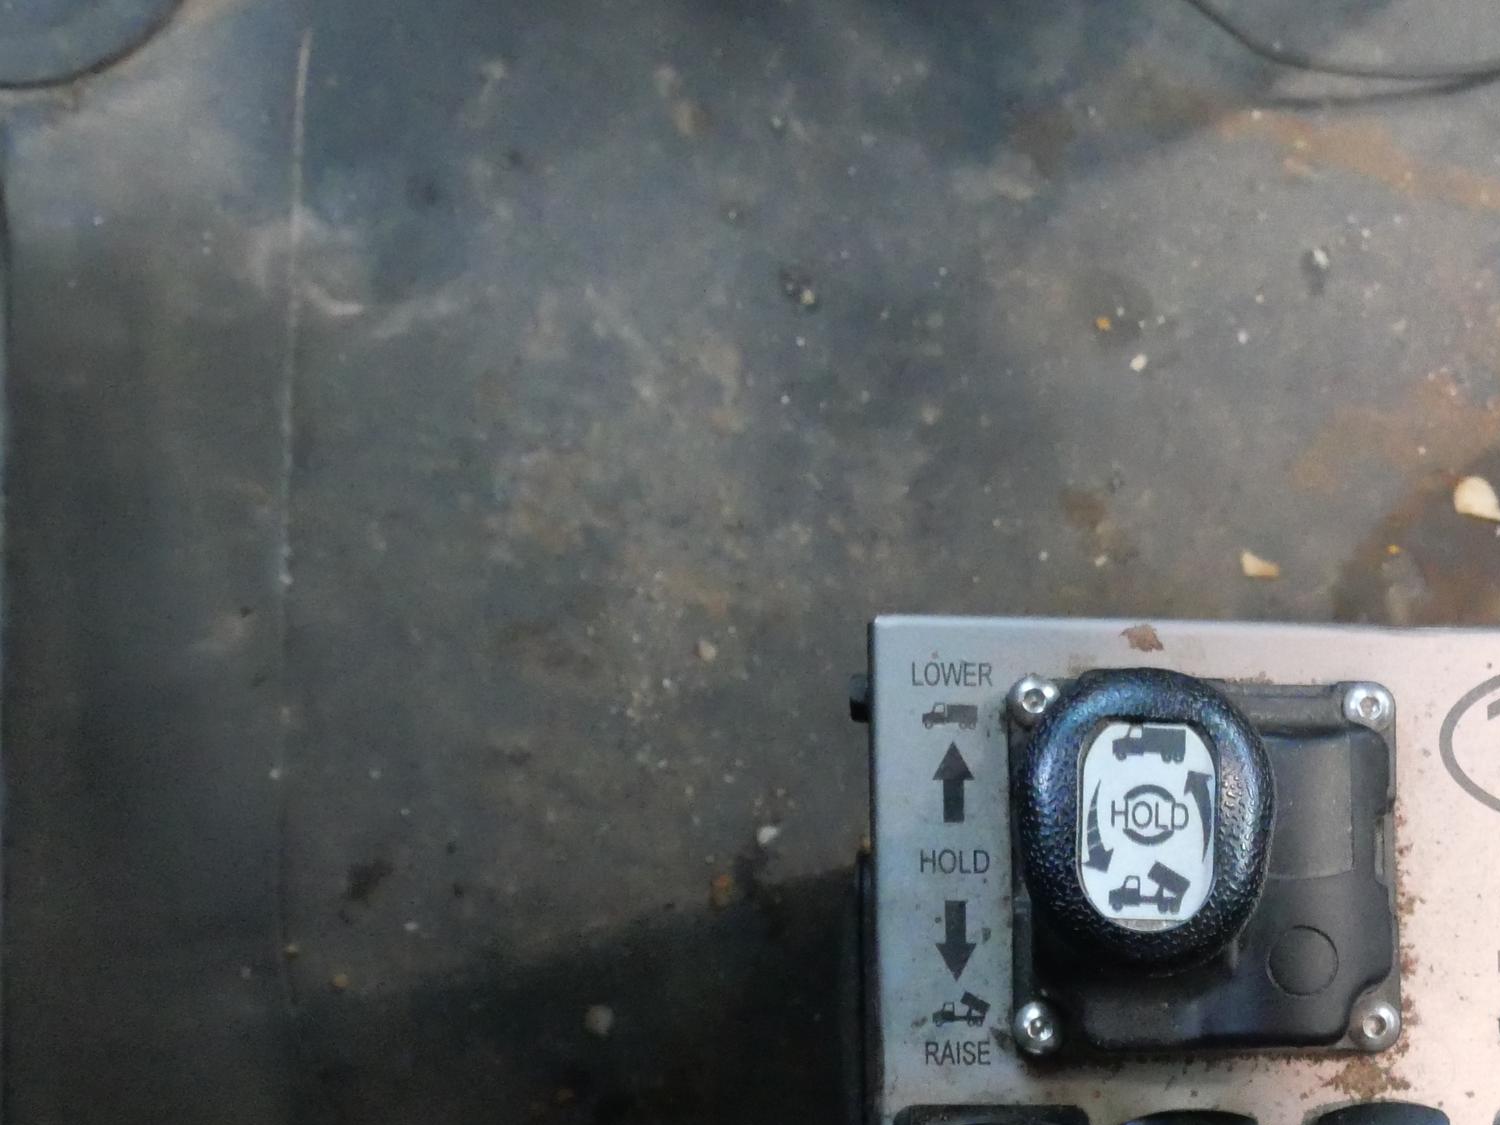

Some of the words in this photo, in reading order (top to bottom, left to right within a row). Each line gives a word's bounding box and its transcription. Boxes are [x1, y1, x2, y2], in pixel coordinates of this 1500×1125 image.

[911, 662, 993, 688] LOWER
[1110, 799, 1190, 829] HOLD
[919, 848, 990, 875] HOLD
[924, 1041, 991, 1066] RAISE
